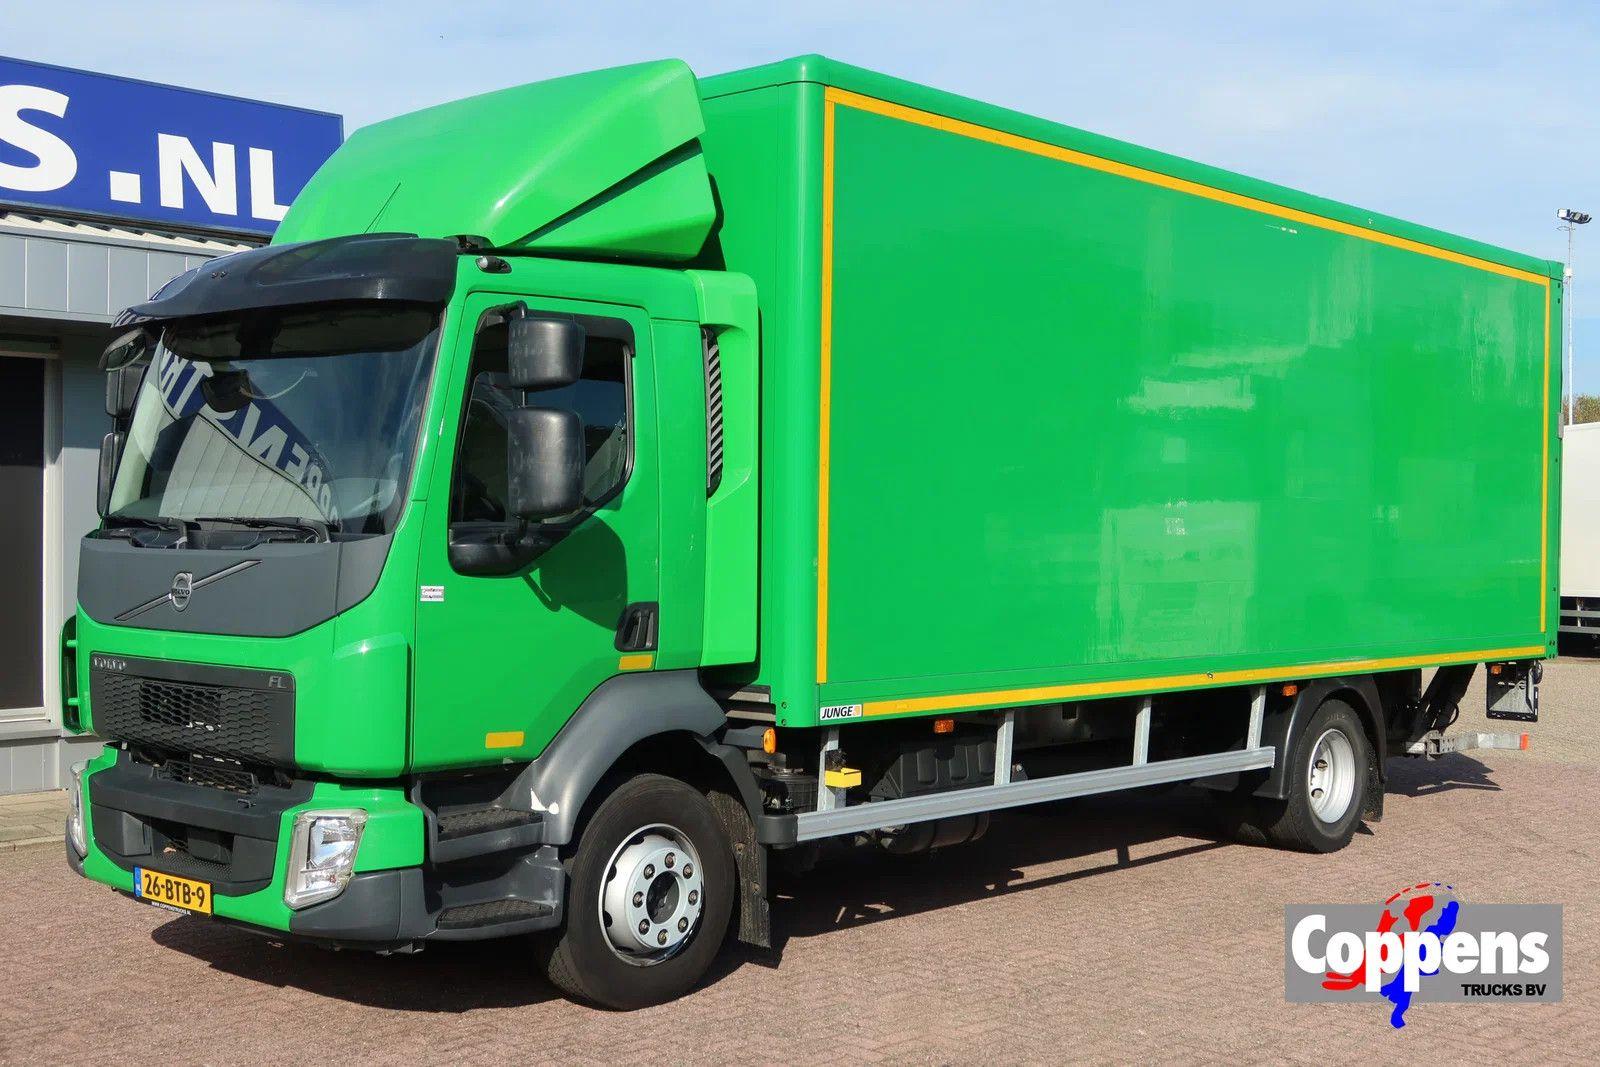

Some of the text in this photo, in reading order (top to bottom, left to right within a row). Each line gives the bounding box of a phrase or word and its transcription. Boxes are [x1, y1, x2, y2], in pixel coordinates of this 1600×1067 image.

[268, 675, 288, 689] FL
[821, 705, 854, 719] JUNGE
[144, 873, 206, 908] 26-BTB-9
